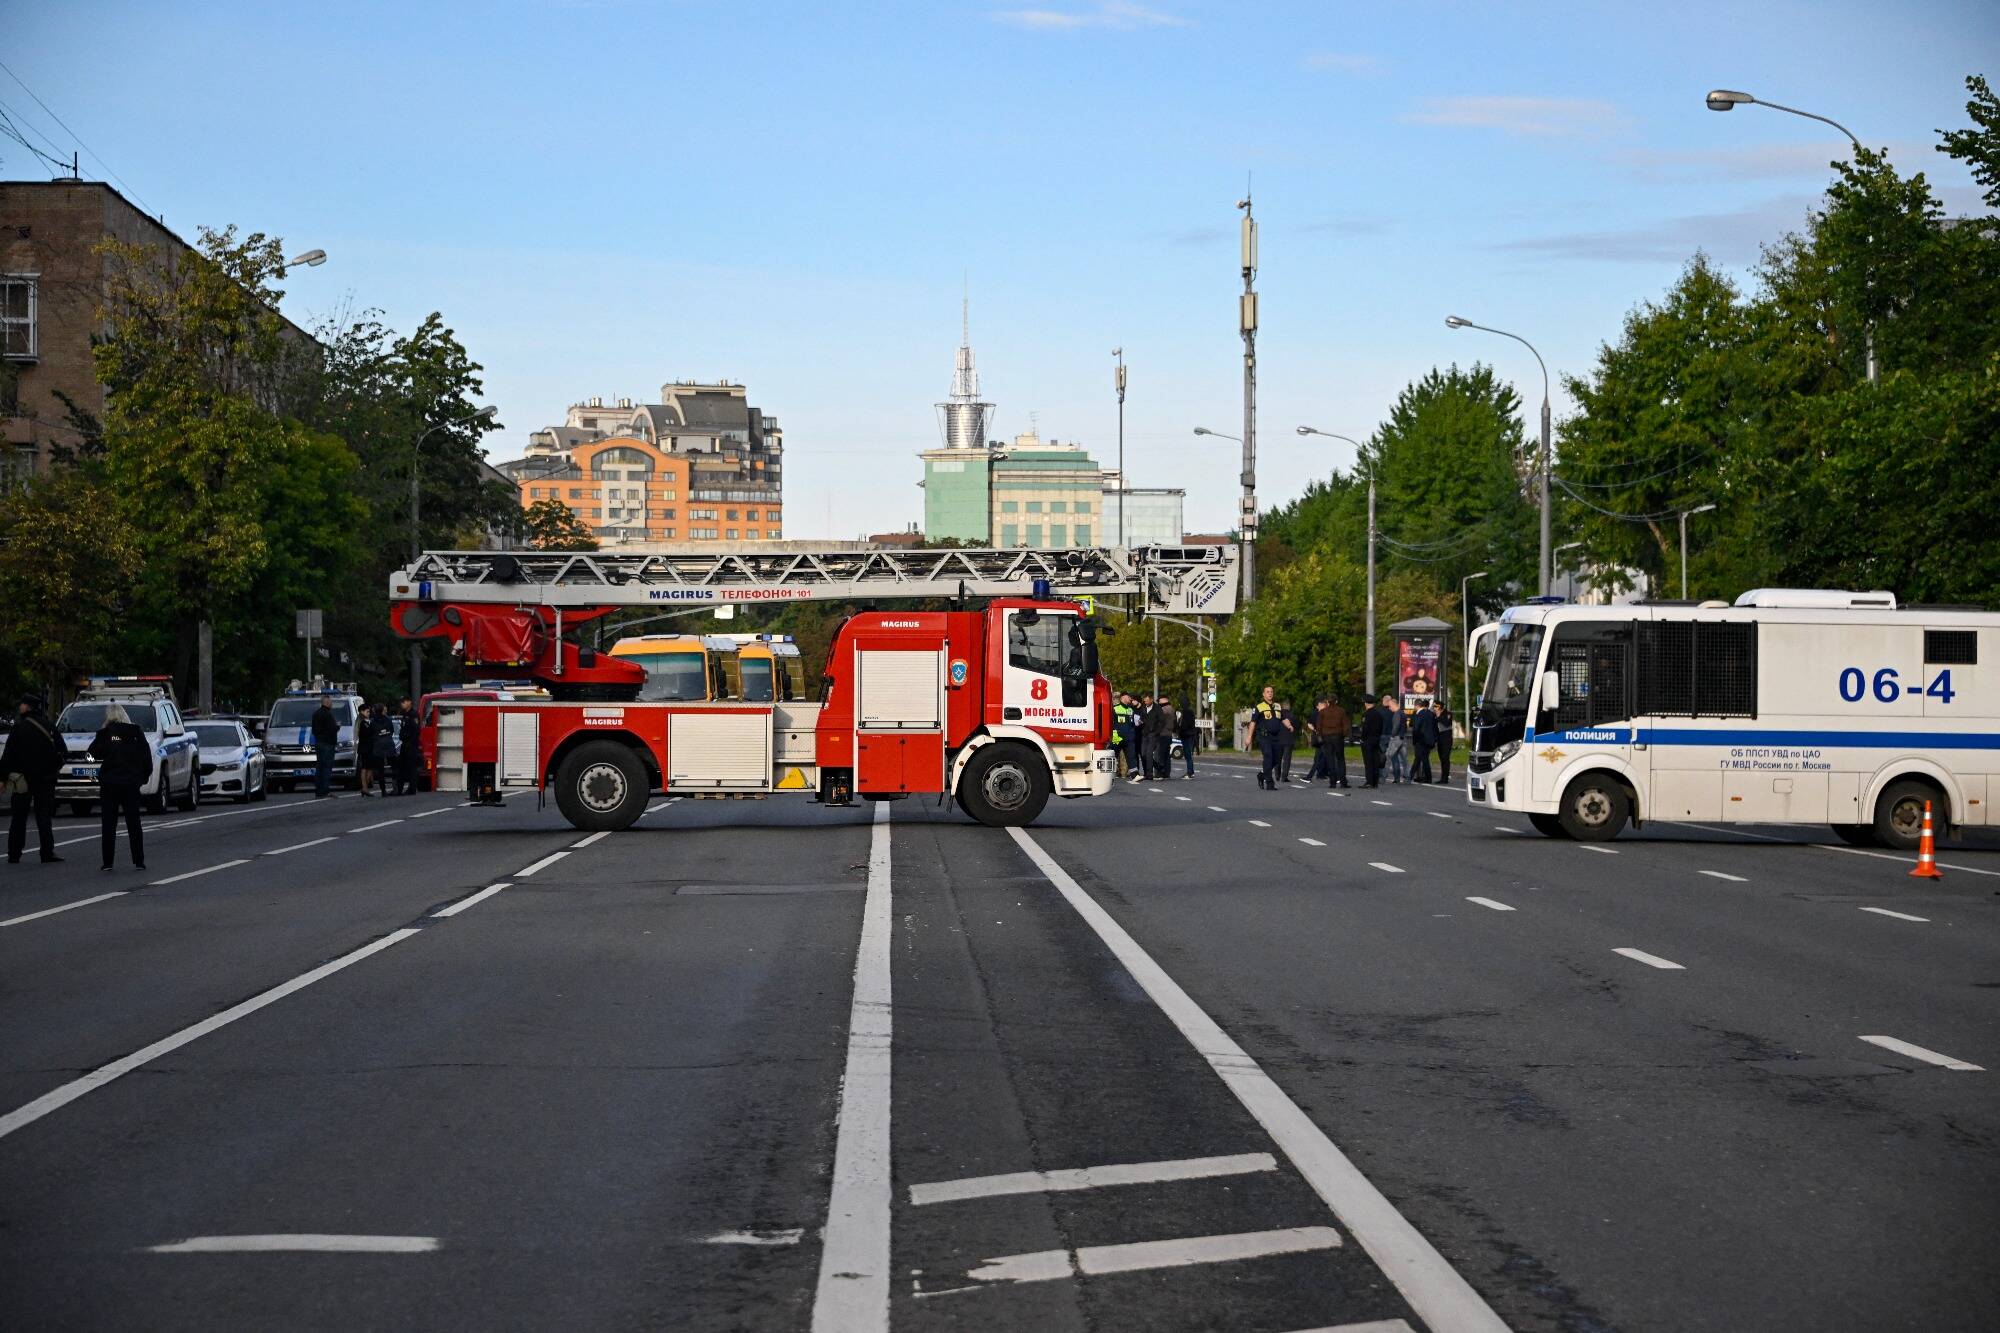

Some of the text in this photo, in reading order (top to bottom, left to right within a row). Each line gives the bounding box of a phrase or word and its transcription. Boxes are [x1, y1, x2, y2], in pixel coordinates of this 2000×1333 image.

[649, 590, 713, 599] MAGIRUS
[720, 589, 780, 599] ТЕЛЕФОН
[796, 590, 811, 598] 101
[1196, 579, 1226, 609] MAGIRUS
[881, 620, 920, 628] MAGIRUS
[1030, 678, 1048, 700] 8
[1838, 667, 1956, 704] 06-4
[1024, 707, 1064, 717] МОСКВА
[584, 718, 624, 726] MAGIRUS
[1565, 731, 1616, 741] ПОЛИЦИЯ
[1730, 748, 1744, 757] ОБ
[1745, 748, 1770, 758] ППСП
[1771, 749, 1789, 759] УВД
[1802, 750, 1821, 759] ЦАО
[1720, 760, 1730, 769] ГУ
[1732, 760, 1751, 770] МВД
[1752, 760, 1781, 769] России
[1783, 762, 1793, 770] по
[1801, 761, 1831, 770] Москве
